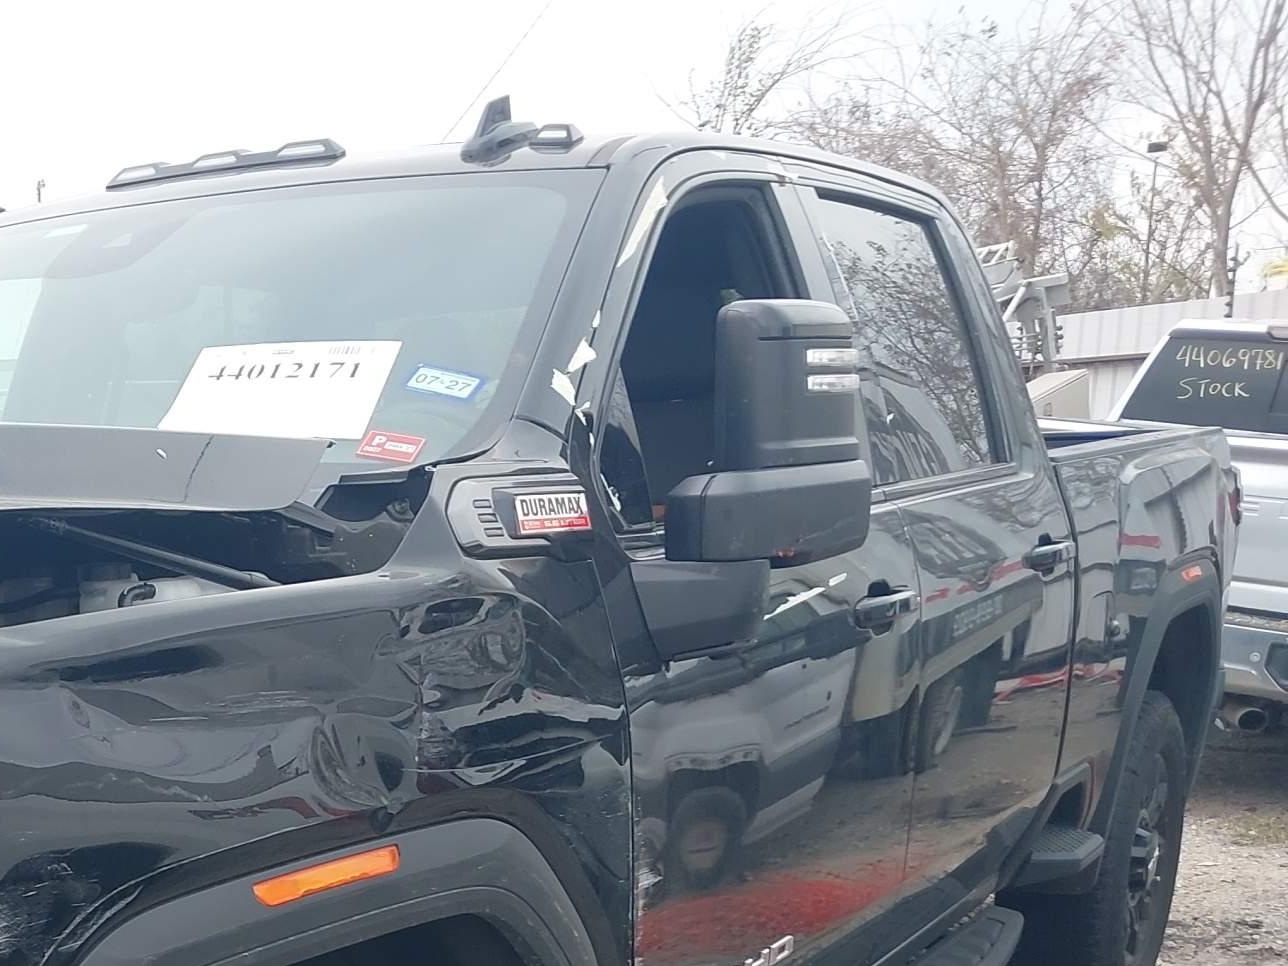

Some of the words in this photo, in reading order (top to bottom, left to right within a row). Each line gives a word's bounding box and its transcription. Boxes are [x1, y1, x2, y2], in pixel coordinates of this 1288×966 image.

[1175, 344, 1284, 370] 44069781
[207, 361, 361, 381] 44012171
[1175, 376, 1251, 400] STOCK
[519, 496, 584, 517] DURAMAX
